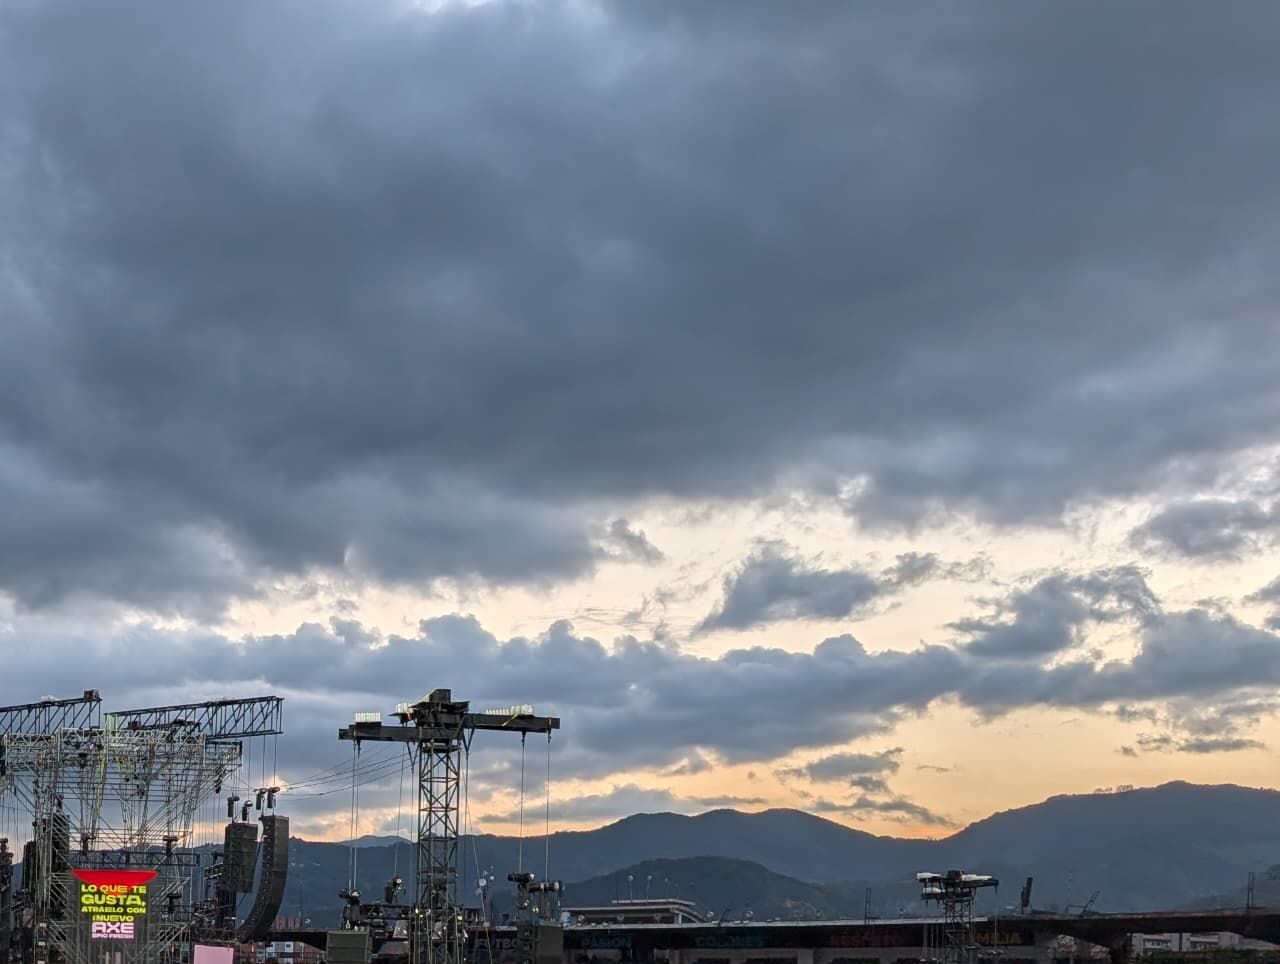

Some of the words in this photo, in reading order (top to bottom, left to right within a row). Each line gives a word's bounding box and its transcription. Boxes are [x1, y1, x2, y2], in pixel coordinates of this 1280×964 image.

[100, 885, 128, 894] QUE
[133, 886, 147, 894] TE
[81, 894, 146, 906] GUSTA,
[91, 922, 135, 933] AXE
